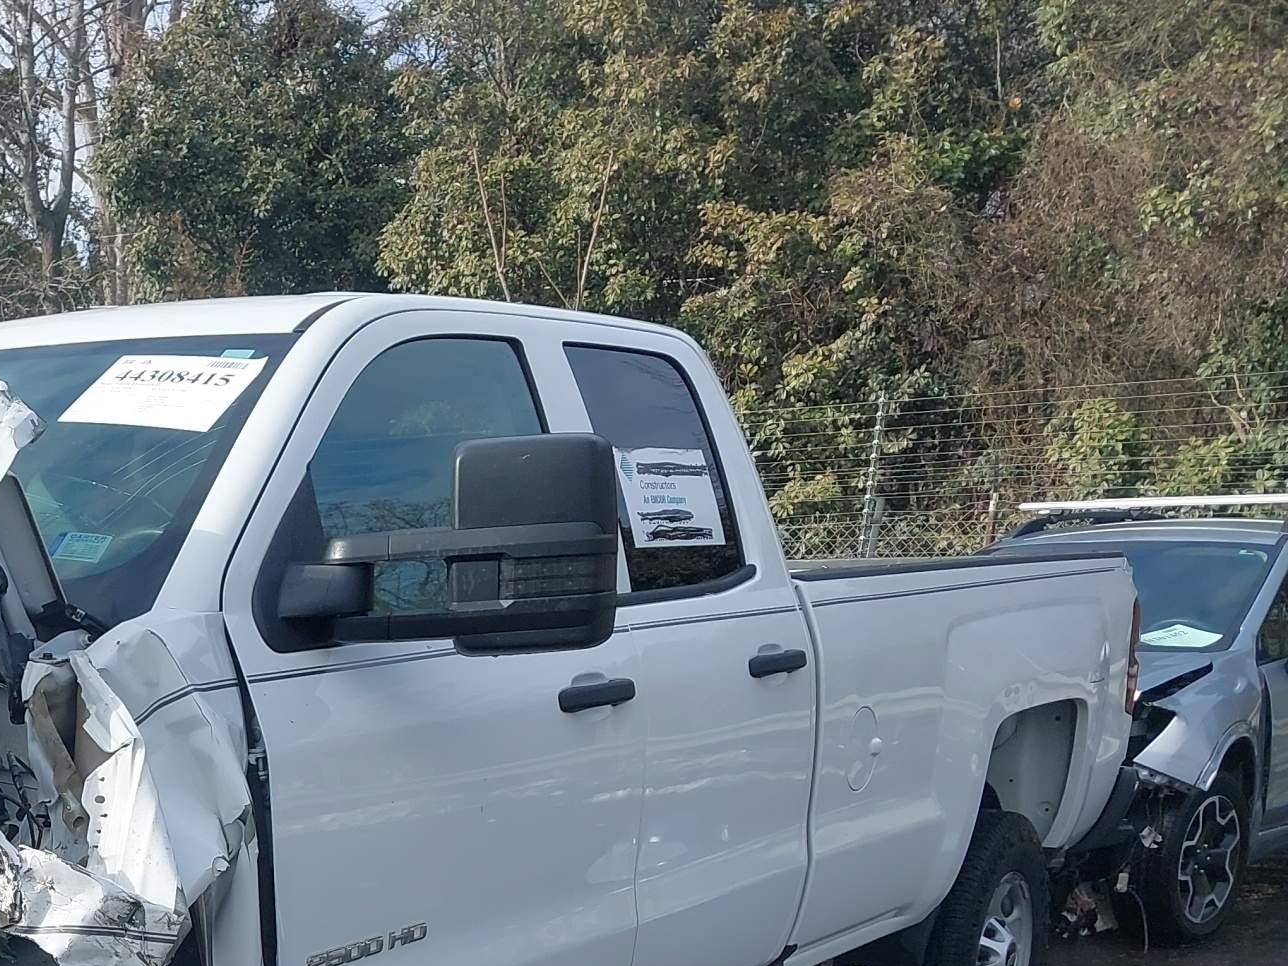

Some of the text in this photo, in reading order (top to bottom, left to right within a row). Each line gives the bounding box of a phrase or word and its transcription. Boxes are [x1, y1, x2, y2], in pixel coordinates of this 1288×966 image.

[114, 369, 236, 387] 44308415
[639, 480, 677, 490] Constructors
[643, 495, 650, 504] An
[667, 495, 687, 506] Company
[388, 921, 428, 951] HD
